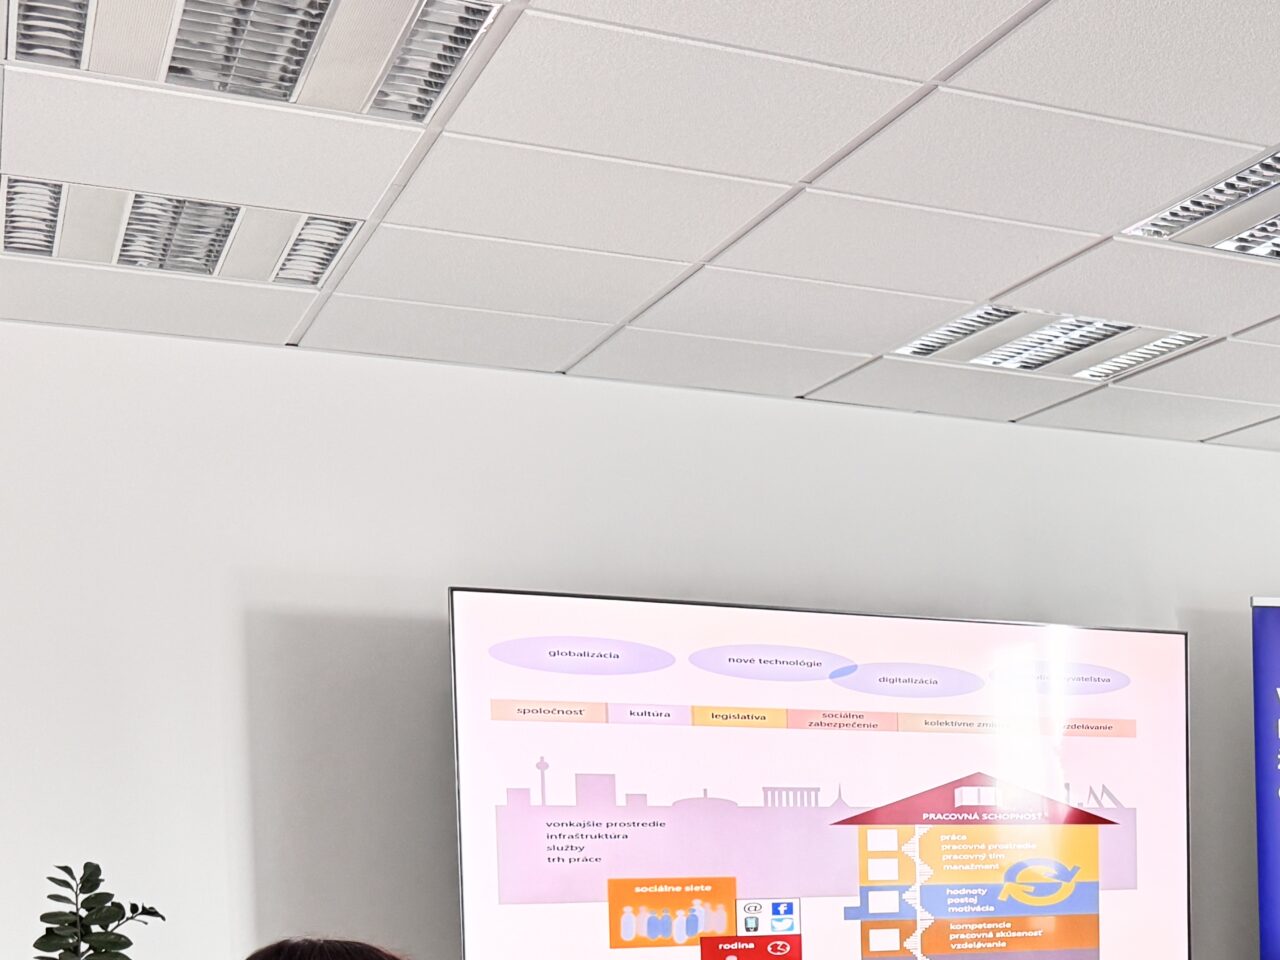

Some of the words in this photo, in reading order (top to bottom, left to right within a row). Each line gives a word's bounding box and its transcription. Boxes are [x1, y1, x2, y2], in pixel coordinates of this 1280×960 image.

[548, 648, 620, 660] globalizácia
[728, 656, 756, 665] nové
[758, 656, 823, 668] technológie
[878, 674, 939, 687] digitalizácia
[516, 705, 586, 717] spoločnosť
[629, 708, 671, 719] kultúra
[822, 710, 865, 720] sociálne
[711, 711, 767, 723] legislatíva
[808, 720, 879, 730] zabezpečenie
[924, 718, 975, 728] kolektívne
[922, 811, 980, 821] PRACOVNÁ
[545, 819, 603, 830] vonkajšie
[605, 819, 667, 831] prostredie
[546, 831, 629, 841] infraštruktúra
[546, 843, 585, 854] služby
[547, 855, 566, 863] trh
[568, 855, 602, 865] práce
[634, 883, 682, 894] sociálne
[684, 882, 713, 893] siete
[946, 887, 988, 897] hodnoty
[947, 896, 979, 905] postoj
[948, 904, 996, 913] motivácia
[950, 921, 1012, 931] kompetencie
[718, 941, 755, 951] rodina
